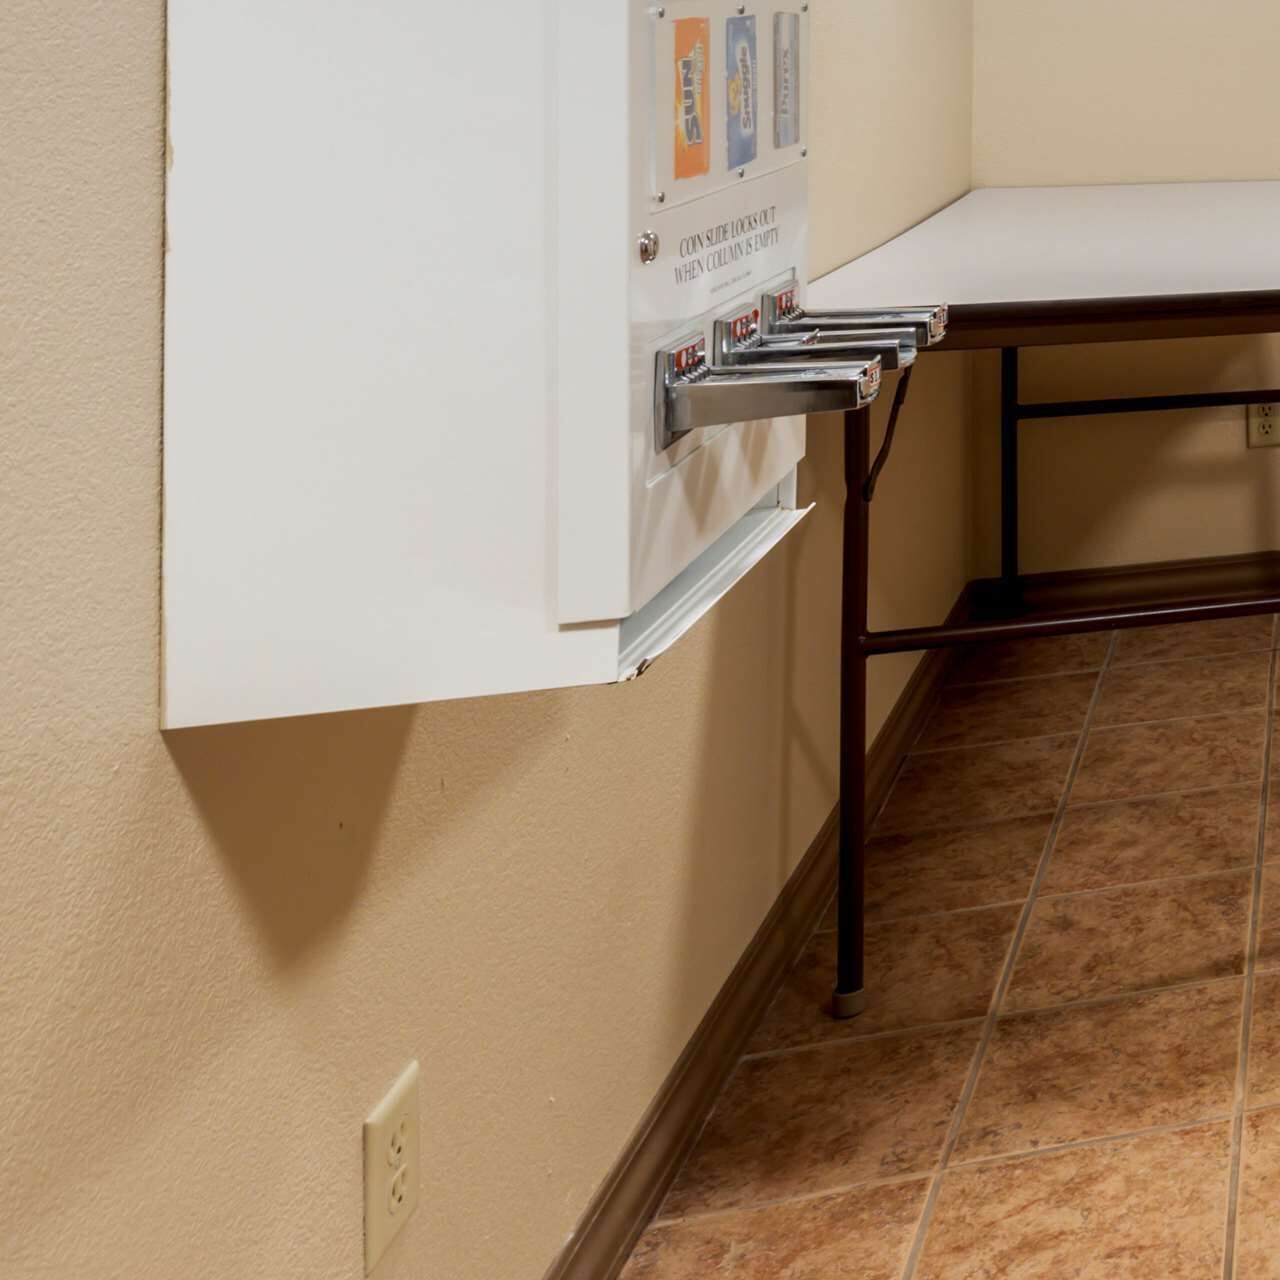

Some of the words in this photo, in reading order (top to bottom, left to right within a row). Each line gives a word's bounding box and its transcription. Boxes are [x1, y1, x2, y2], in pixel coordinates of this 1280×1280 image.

[682, 58, 703, 145] SUN
[740, 46, 752, 129] Snuggle
[674, 258, 705, 285] WHEN
[706, 240, 745, 272] COLUMN
[745, 236, 754, 257] IS
[754, 226, 780, 253] EMPTY
[679, 231, 704, 258] COIN
[705, 222, 730, 248] SLIDE
[731, 211, 759, 238] LOCKS
[759, 206, 776, 226] OUT
